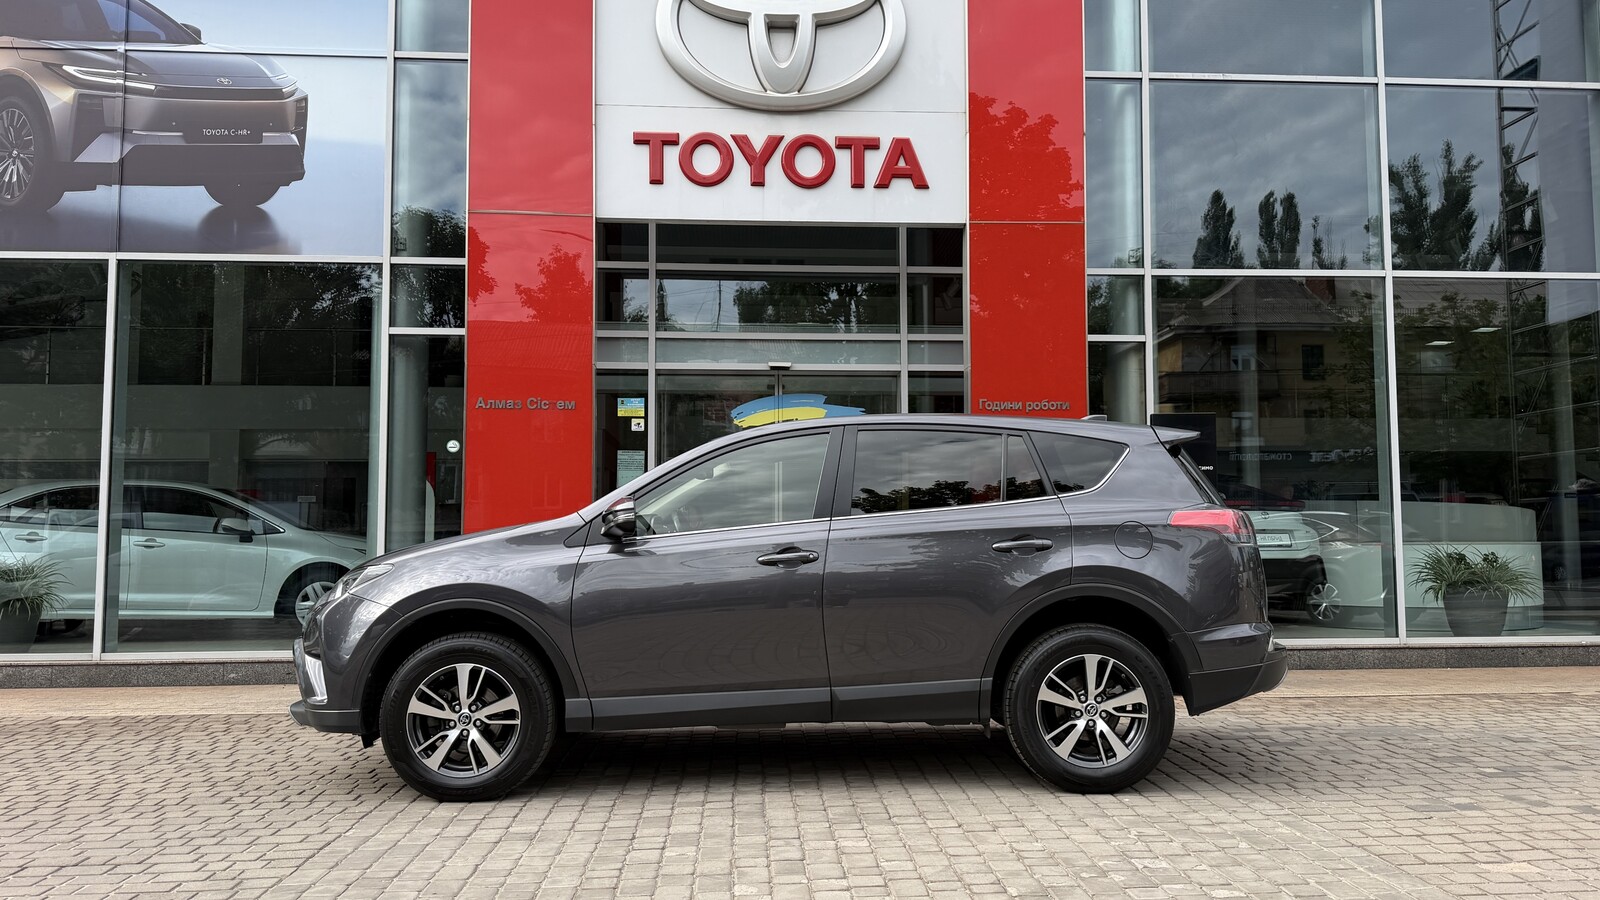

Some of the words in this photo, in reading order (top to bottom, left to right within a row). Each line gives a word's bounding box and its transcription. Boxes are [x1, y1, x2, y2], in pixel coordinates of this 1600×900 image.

[202, 128, 228, 136] TOYOTA
[633, 131, 929, 190] TOYOTA
[475, 397, 522, 409] Алмаз
[527, 397, 576, 410] Сісем
[979, 399, 1023, 412] Години
[1026, 399, 1070, 412] роботи
